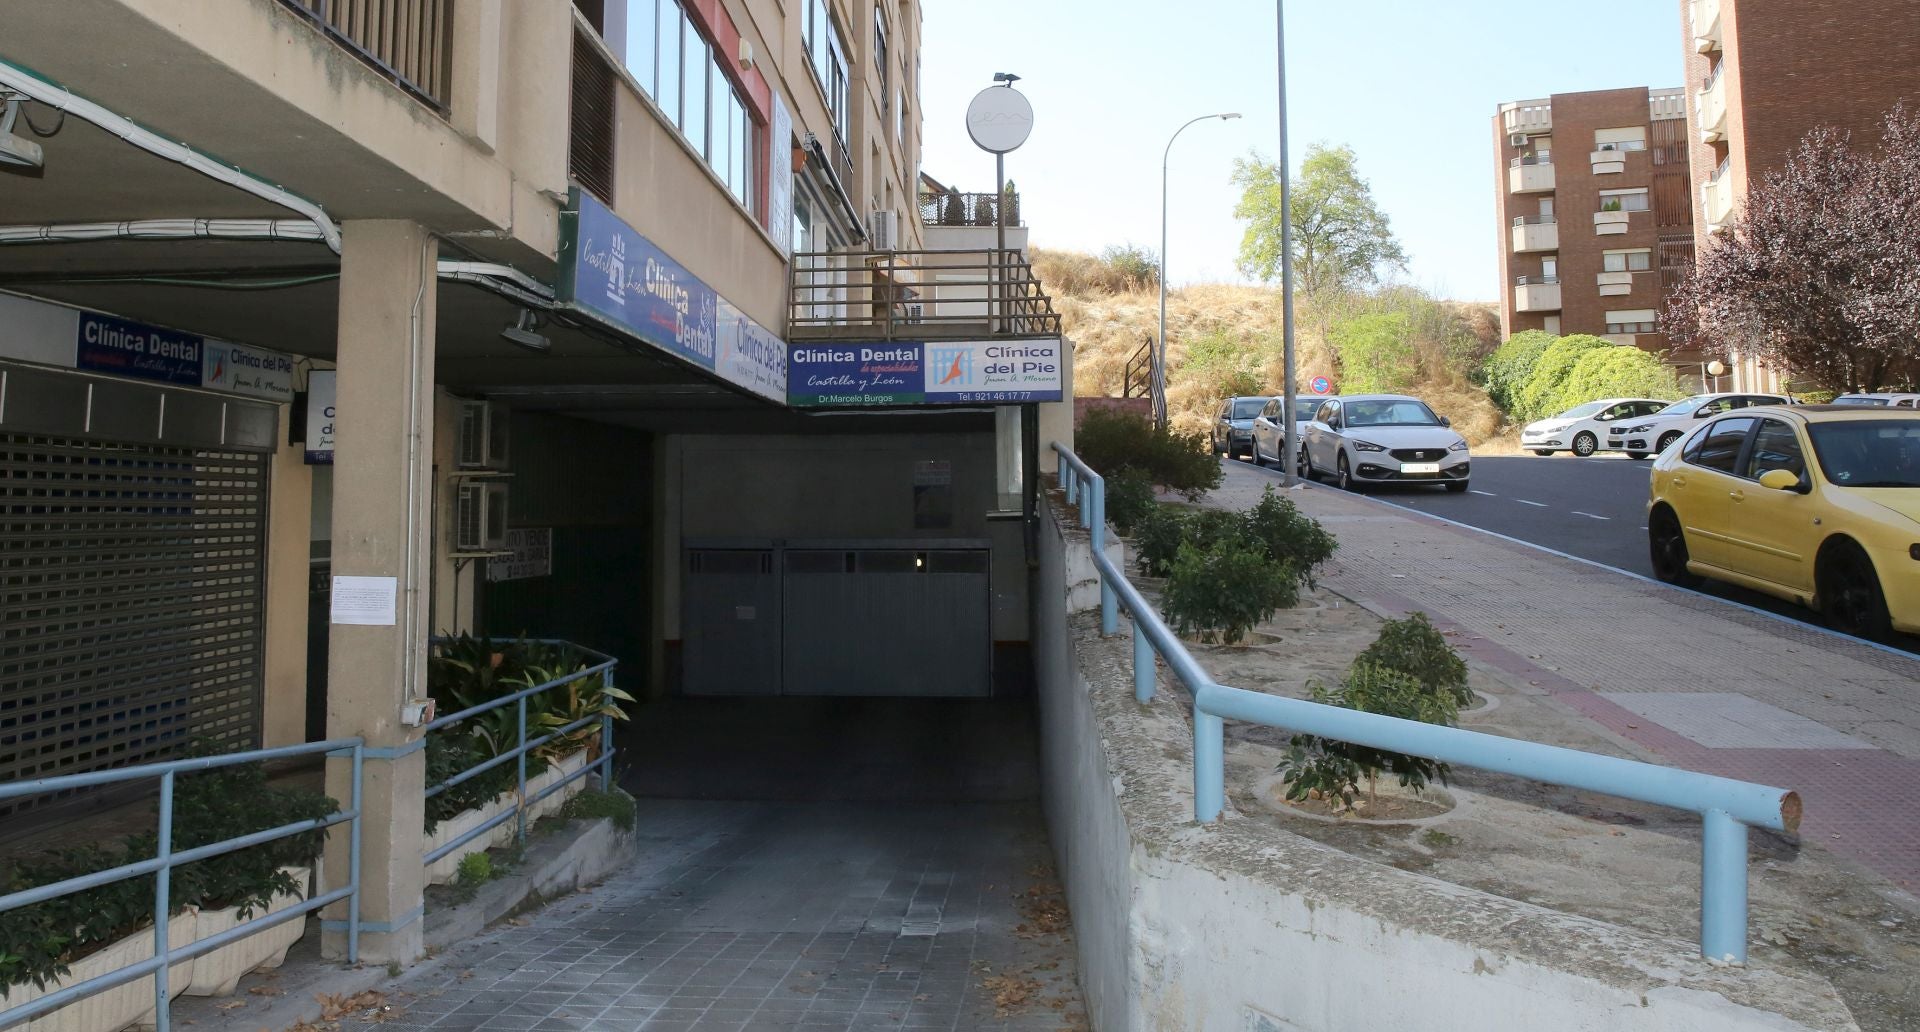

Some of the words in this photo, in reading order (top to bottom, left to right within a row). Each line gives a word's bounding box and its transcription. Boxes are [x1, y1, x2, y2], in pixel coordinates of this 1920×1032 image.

[645, 258, 688, 315] Clínica
[85, 321, 144, 352] Clínica
[149, 333, 198, 361] Dental
[675, 311, 713, 358] Dental
[737, 318, 763, 364] Clínica
[765, 337, 775, 371] del
[777, 344, 787, 378] Pie
[793, 347, 855, 363] Clínica
[861, 347, 919, 362] Dental
[985, 346, 1053, 358] Clínica
[231, 349, 261, 369] Clínica
[262, 354, 277, 370] del
[277, 358, 292, 374] Pie
[984, 362, 1014, 374] del
[1023, 361, 1055, 373] Pie
[232, 373, 253, 390] Juan
[264, 378, 290, 394] Moreno
[807, 374, 855, 386] Castilla
[858, 380, 868, 391] y
[871, 373, 905, 386] León
[984, 374, 1007, 386] Juan
[1023, 375, 1056, 383] Moreno
[865, 394, 893, 405] Burgos
[957, 392, 972, 401] Tel.
[976, 392, 992, 401] 921
[993, 392, 1004, 401] 46
[1008, 392, 1018, 400] 17
[1020, 391, 1031, 400] 77
